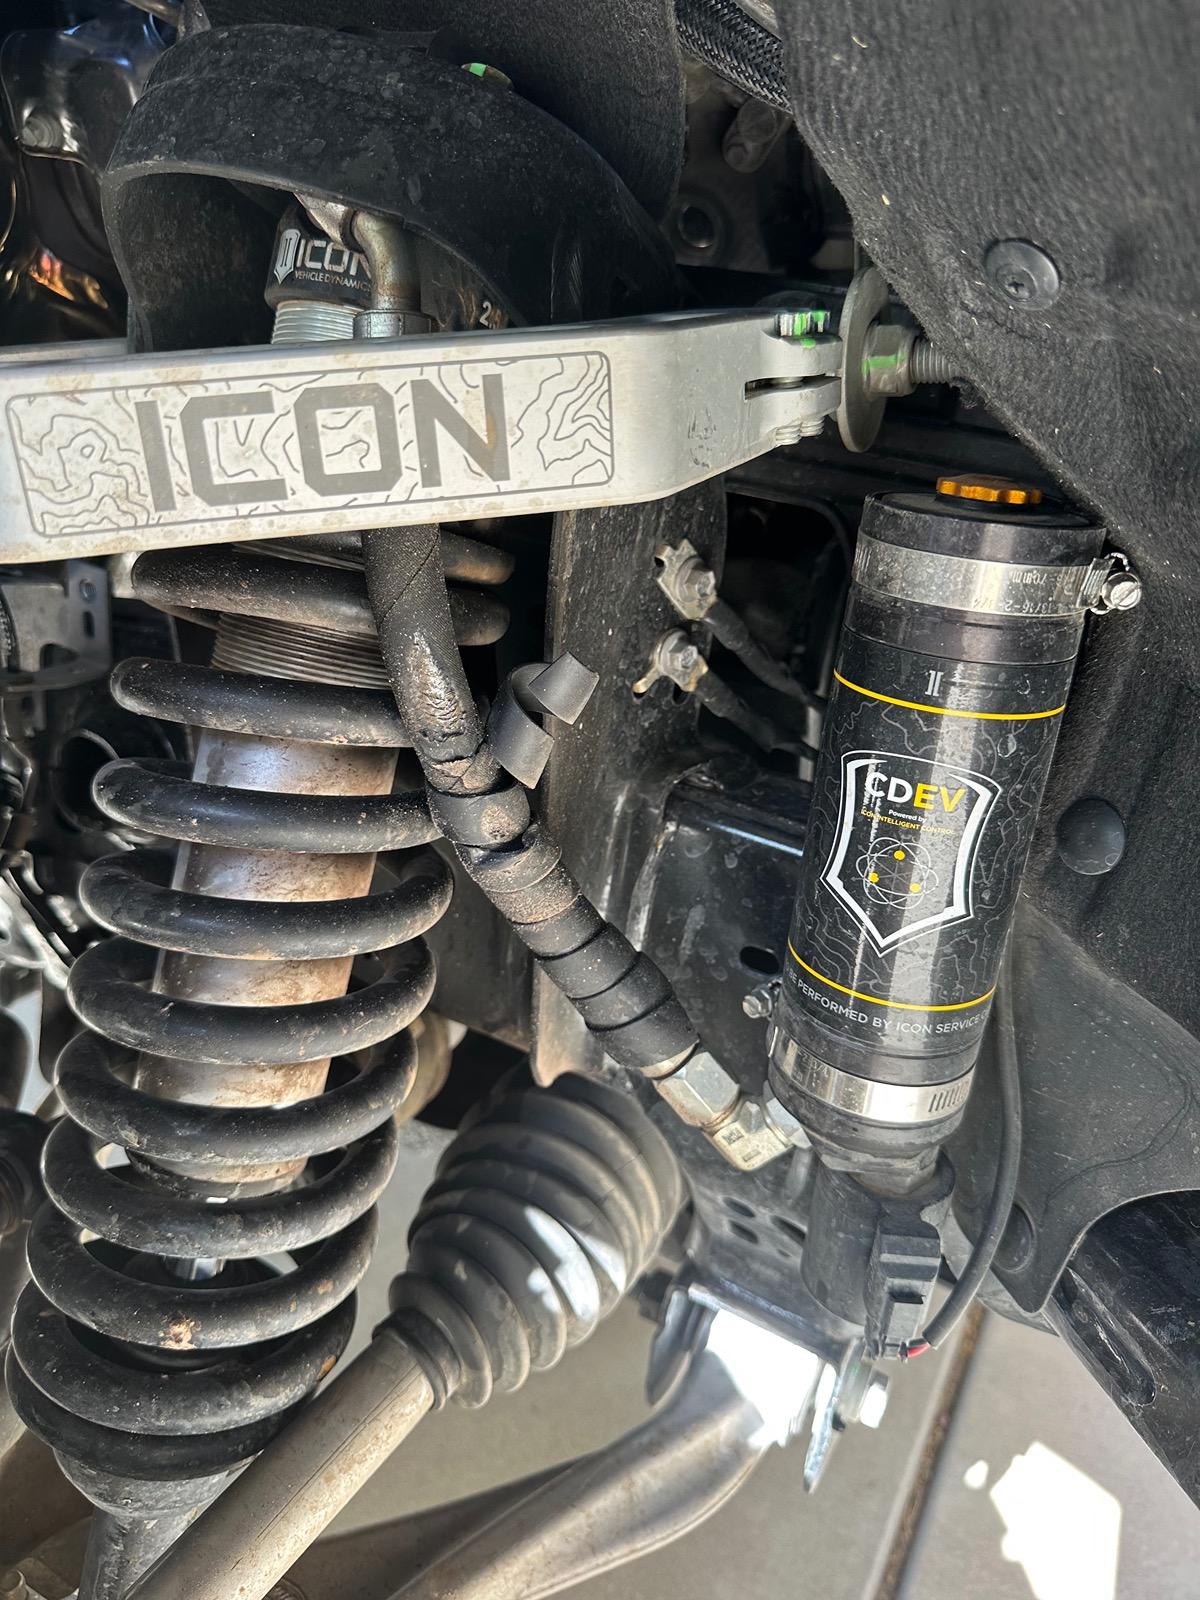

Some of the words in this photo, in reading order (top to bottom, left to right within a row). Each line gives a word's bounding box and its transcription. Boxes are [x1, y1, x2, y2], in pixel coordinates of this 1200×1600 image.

[294, 238, 371, 278] ICON
[295, 269, 324, 282] VEHICLE
[135, 374, 510, 512] ICON
[865, 772, 965, 812] CDEV
[861, 807, 877, 819] ICON
[878, 815, 920, 830] INTELLIGENT
[920, 824, 956, 835] CONTROL
[888, 809, 917, 821] Powered
[918, 814, 928, 824] by
[797, 978, 869, 1024] PERFORMED
[872, 1016, 891, 1030] BY
[896, 1022, 934, 1035] ICON
[935, 1014, 981, 1033] SERVICE
